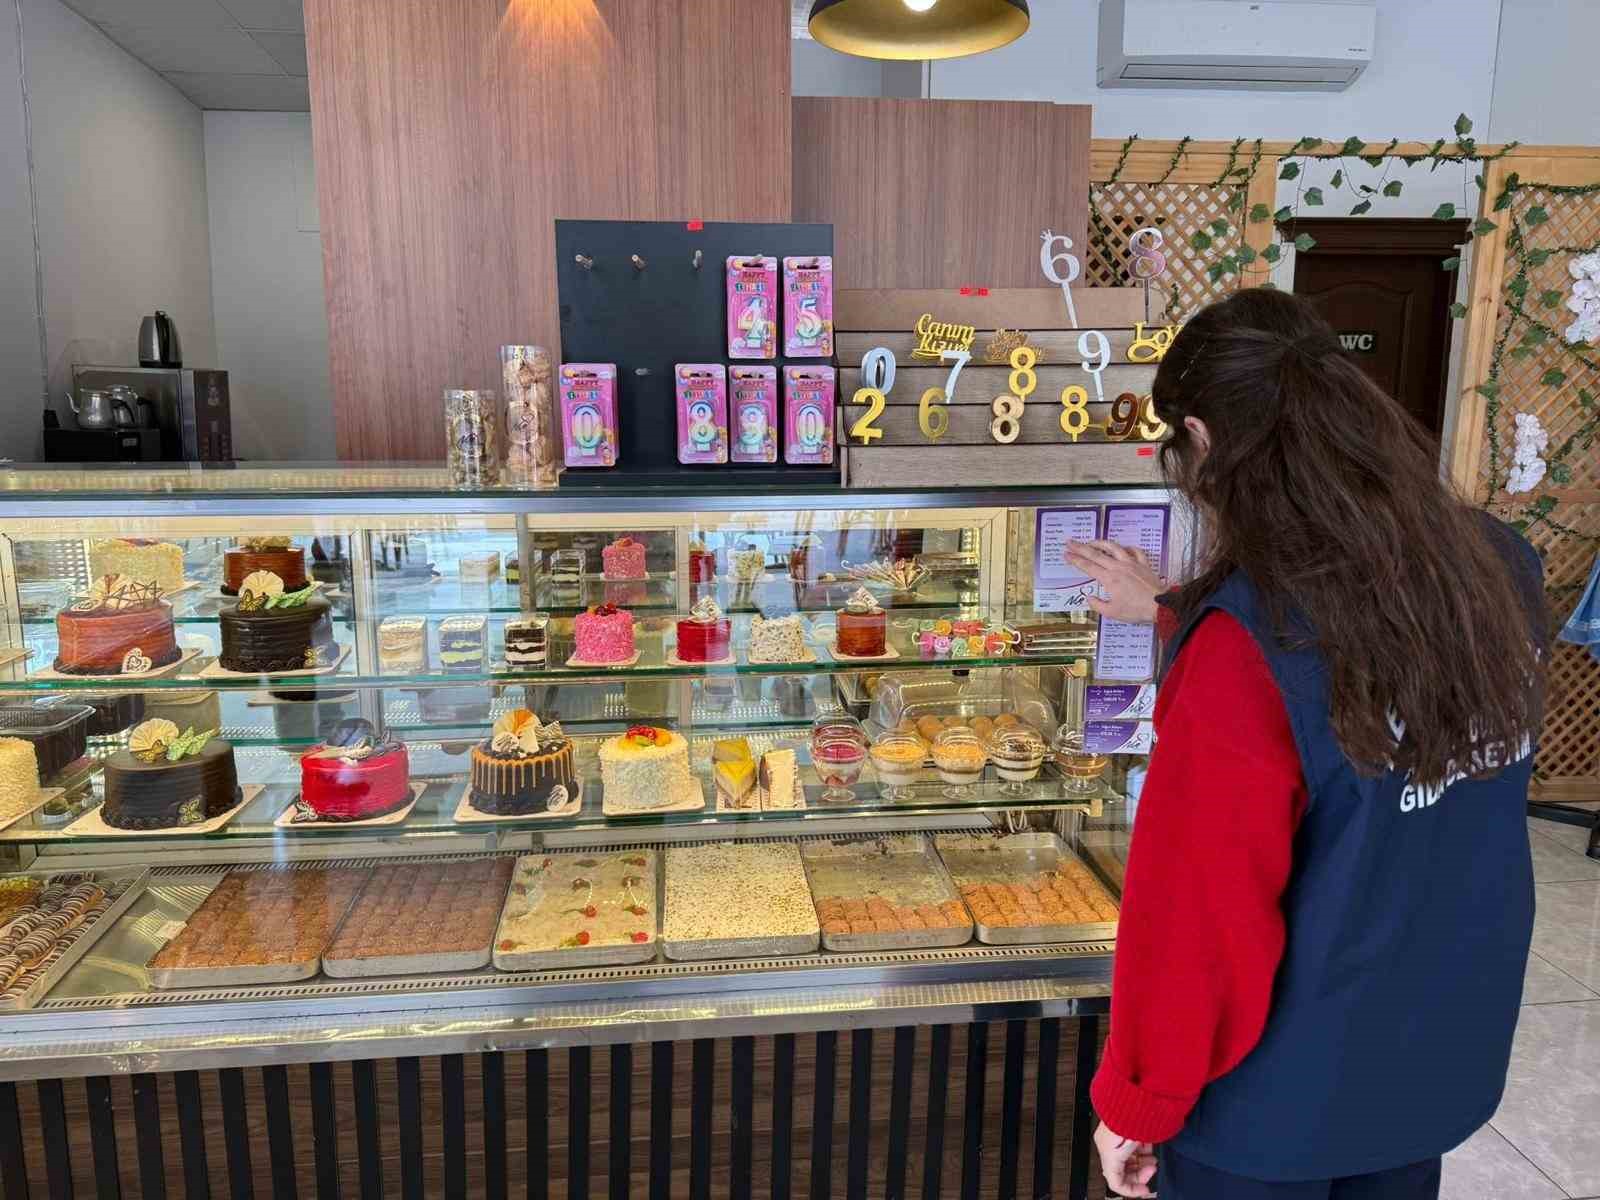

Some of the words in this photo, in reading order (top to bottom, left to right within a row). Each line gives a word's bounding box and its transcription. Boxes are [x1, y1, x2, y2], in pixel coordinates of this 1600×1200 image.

[1040, 231, 1080, 284] 6
[1128, 227, 1167, 279] 8
[737, 296, 769, 341] 4
[796, 298, 825, 339] 5
[1338, 334, 1373, 350] WC
[861, 347, 897, 395] 0
[943, 350, 973, 401] 7
[1009, 347, 1037, 396] 8
[1078, 330, 1111, 374] 9
[572, 404, 603, 449] 0
[688, 400, 718, 444] 8
[795, 402, 826, 448] 0
[850, 387, 886, 440] 2
[918, 387, 949, 441] 6
[991, 395, 1025, 443] 8
[1060, 385, 1090, 434] 8
[1104, 392, 1139, 441] 9
